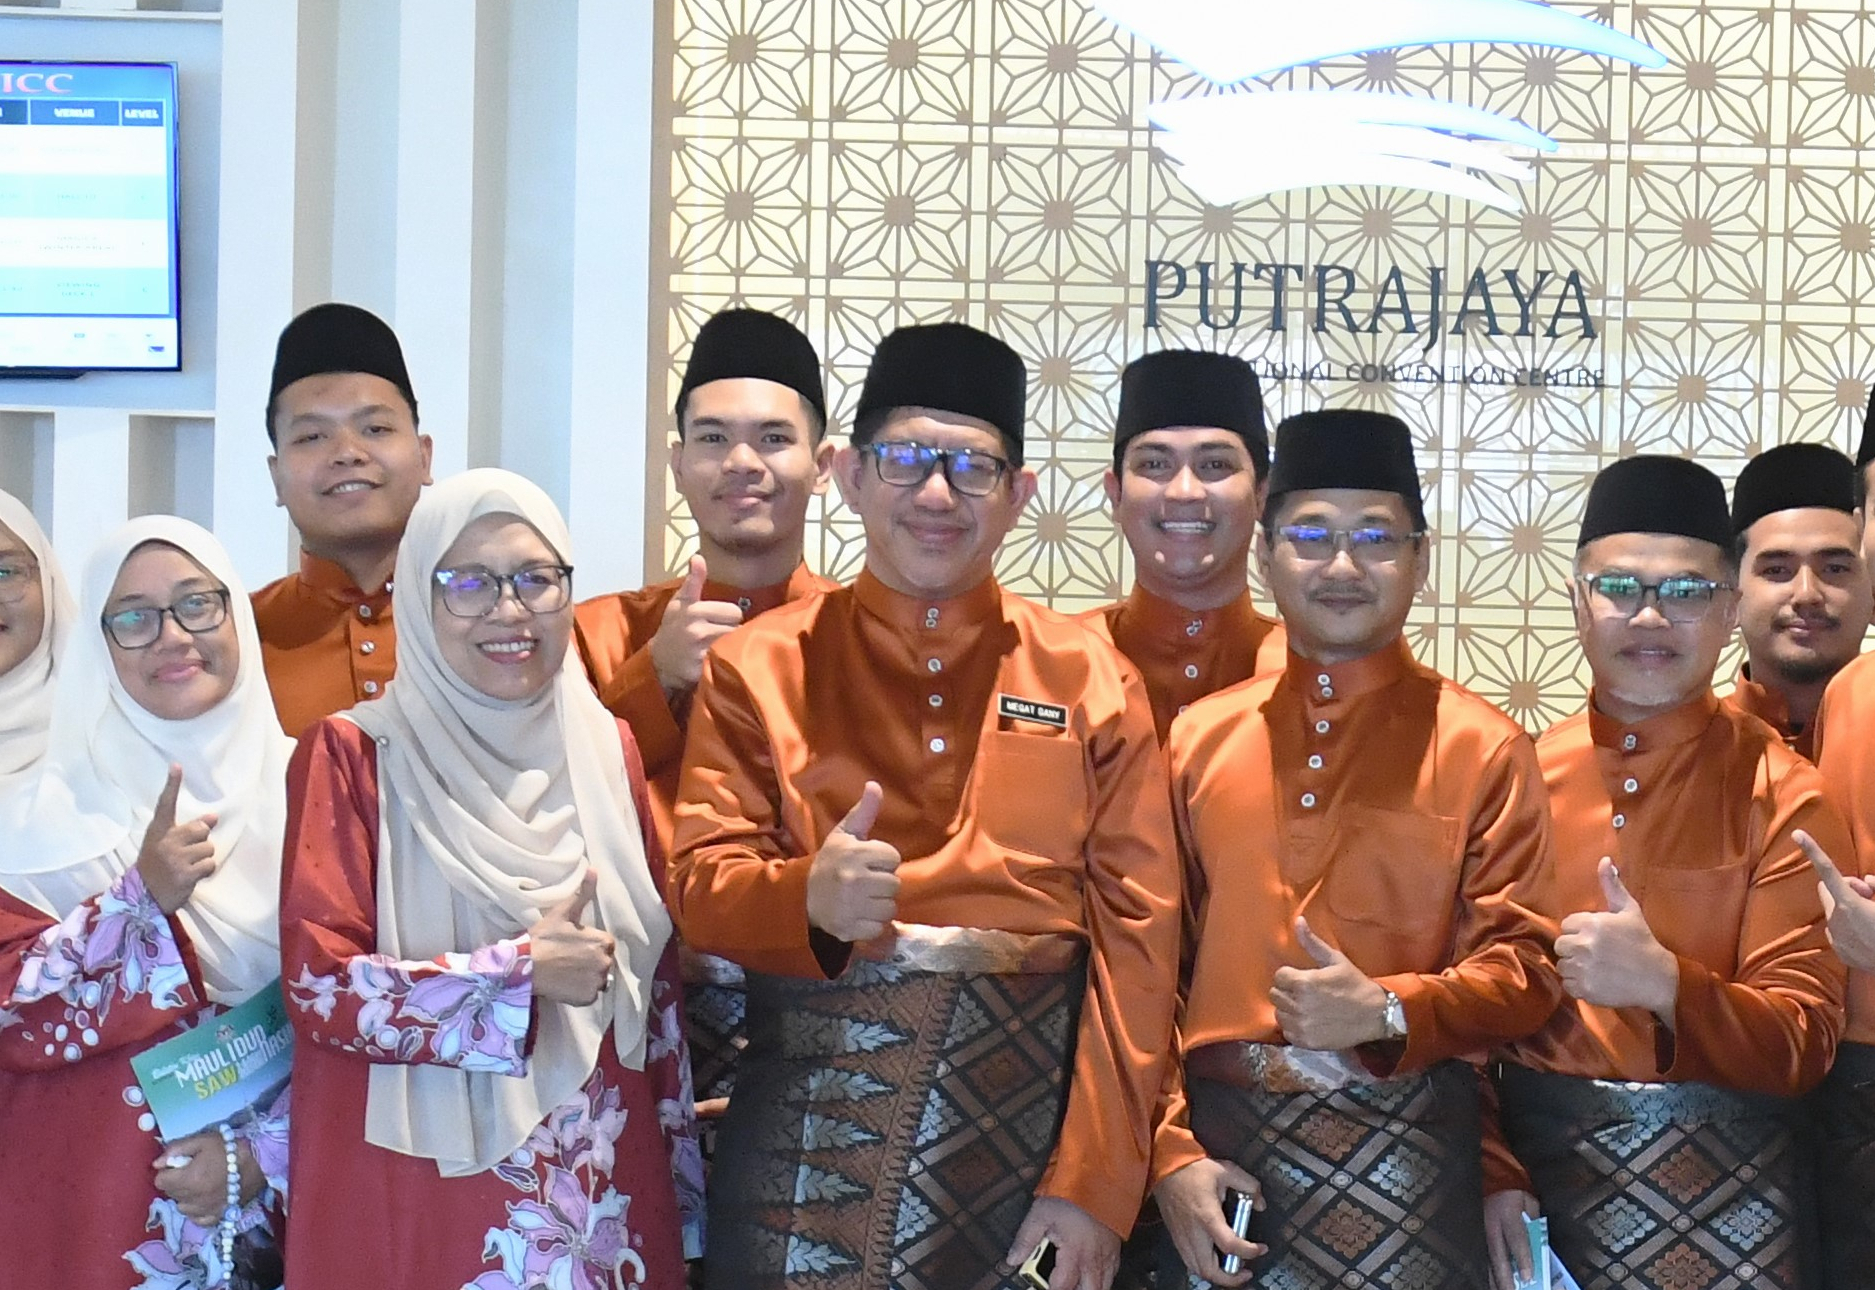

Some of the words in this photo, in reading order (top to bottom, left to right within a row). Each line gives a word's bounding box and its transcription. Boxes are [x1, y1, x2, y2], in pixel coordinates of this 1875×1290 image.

[124, 109, 159, 119] LEVEL
[1142, 259, 1598, 354] PUTRAJAYA
[1346, 362, 1506, 385] CONVENTION
[1513, 367, 1605, 388] CENTRE
[193, 1064, 239, 1100] SAW
